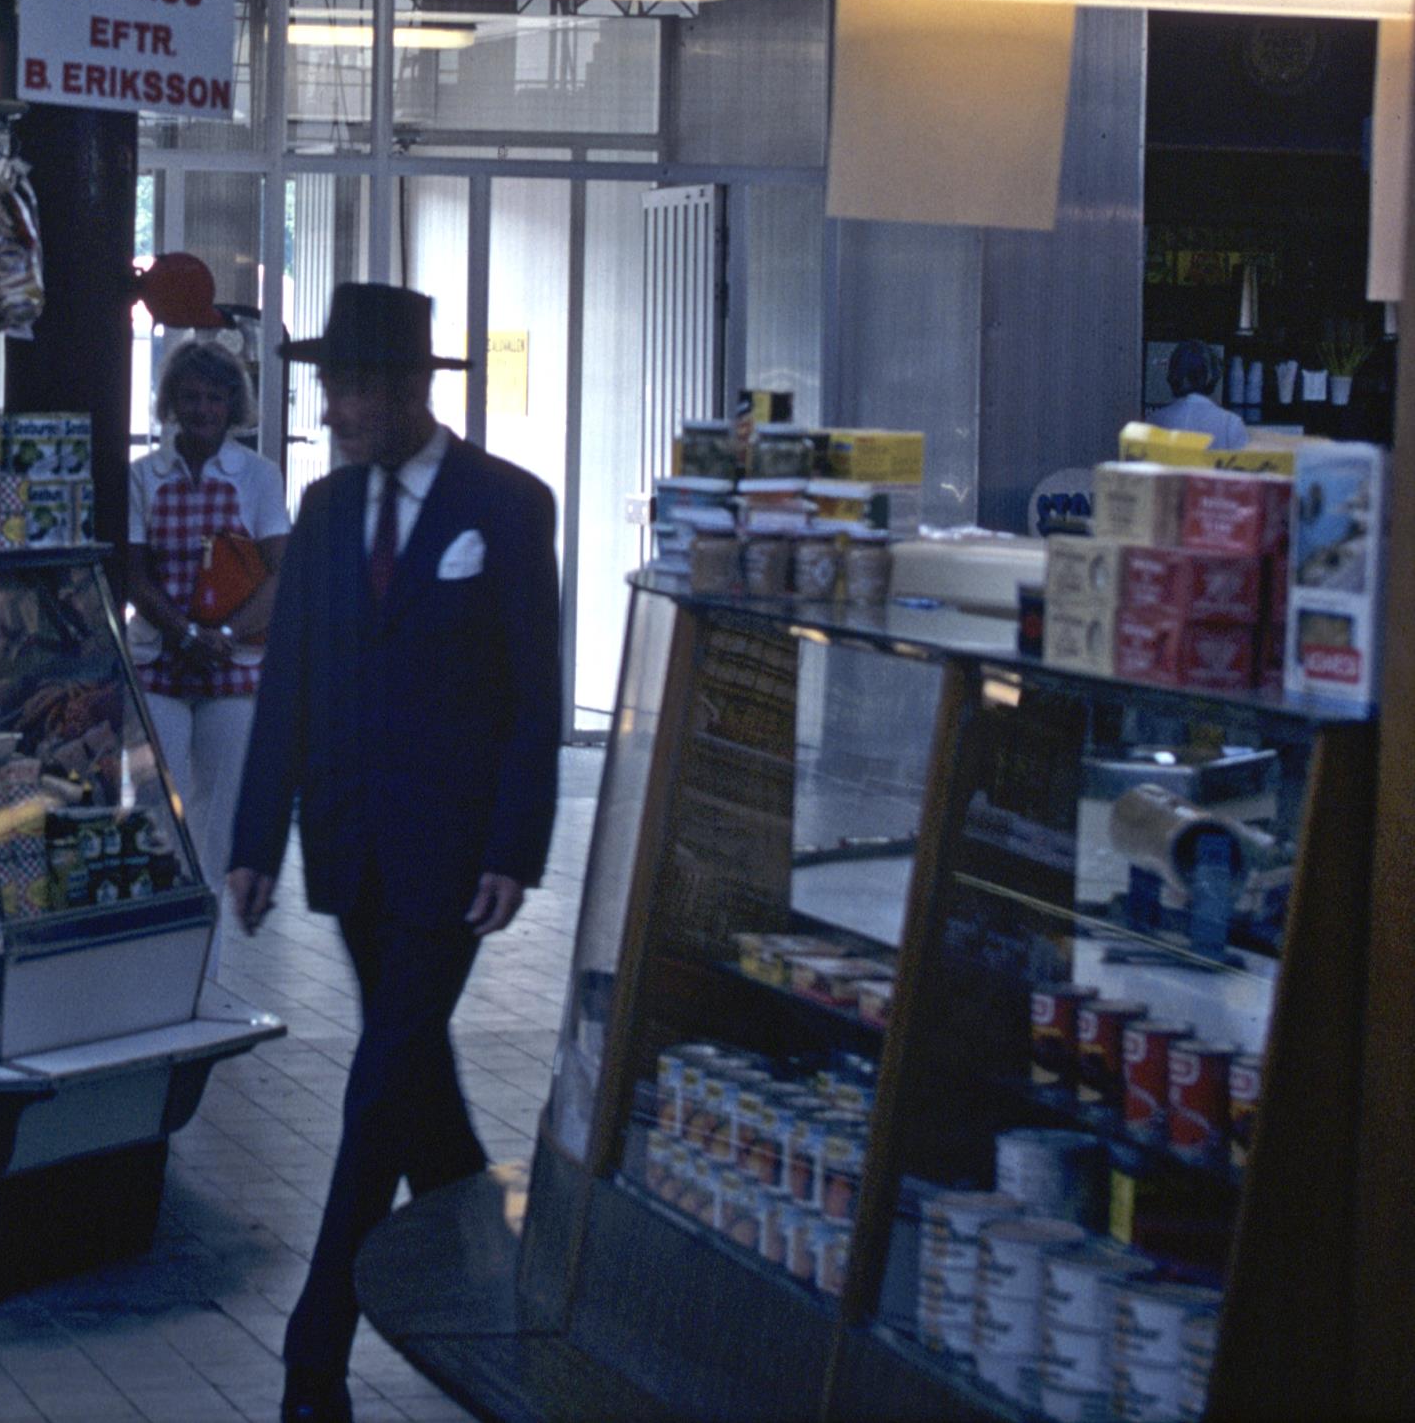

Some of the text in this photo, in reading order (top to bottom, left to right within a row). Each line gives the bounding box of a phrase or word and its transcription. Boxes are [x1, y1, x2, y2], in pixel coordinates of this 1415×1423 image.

[90, 14, 178, 57] EFTR.
[24, 58, 231, 111] B. ERIKSSON
